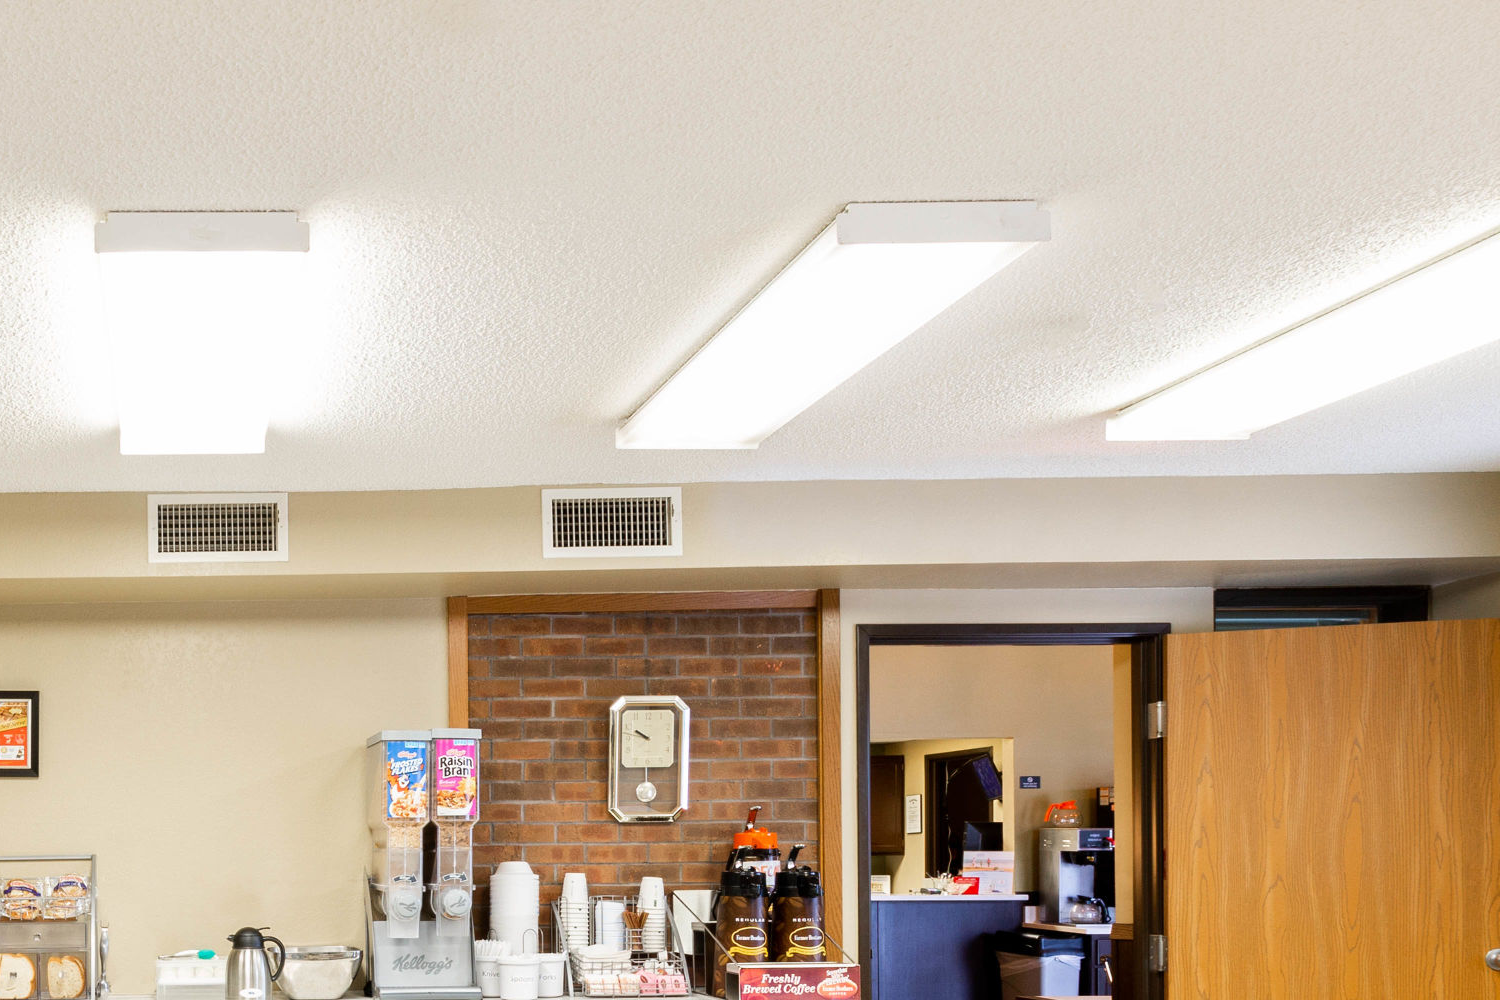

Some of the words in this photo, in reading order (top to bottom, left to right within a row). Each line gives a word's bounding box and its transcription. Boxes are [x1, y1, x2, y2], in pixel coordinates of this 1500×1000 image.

[440, 757, 472, 768] Raisin
[444, 766, 470, 777] Bran
[392, 954, 453, 975] Kellogg's
[482, 970, 500, 978] Knive
[761, 974, 801, 985] Freshly
[742, 984, 782, 995] Brewed
[783, 983, 816, 996] Coffee
